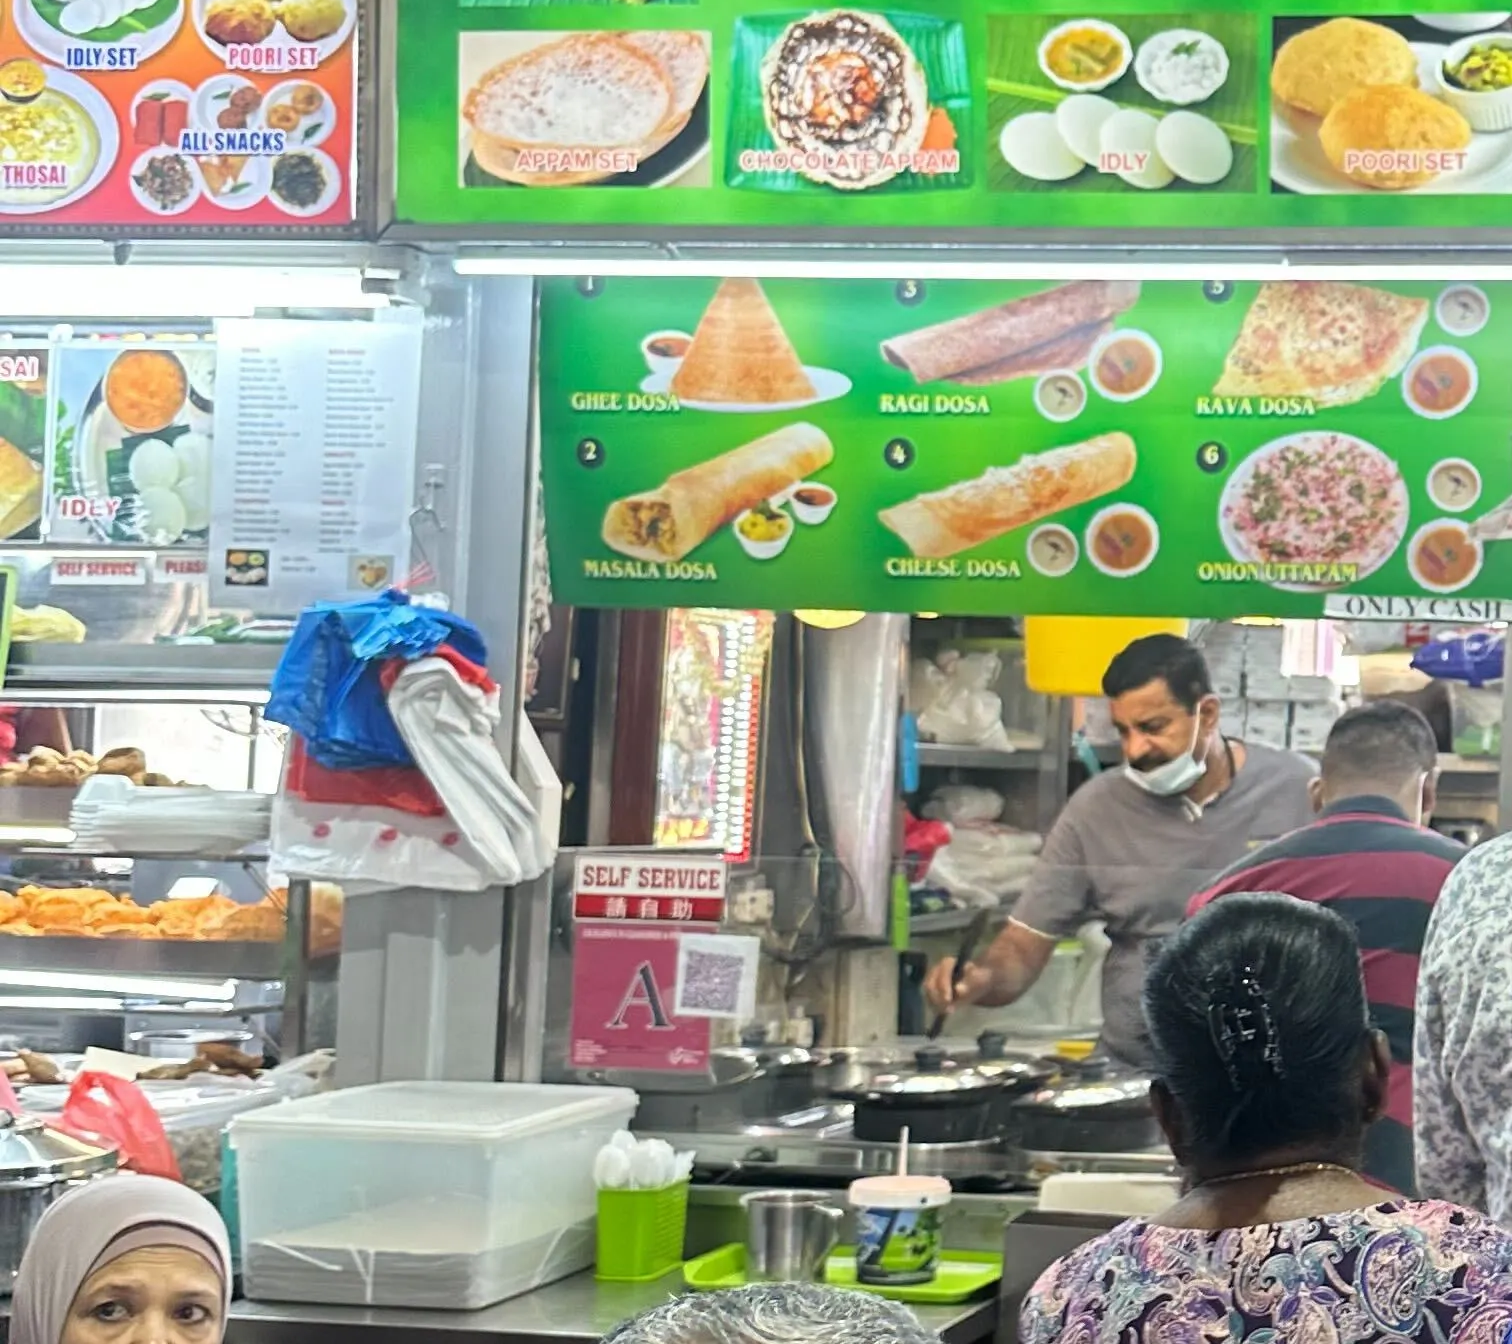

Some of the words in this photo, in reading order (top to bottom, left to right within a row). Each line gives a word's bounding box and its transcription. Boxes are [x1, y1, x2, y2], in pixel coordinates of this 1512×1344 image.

[66, 47, 104, 66] IDLY
[107, 47, 137, 66] SET
[229, 47, 282, 66] POORI
[288, 47, 318, 66] SET
[181, 131, 210, 151] ALL
[214, 131, 284, 152] SNACKS
[517, 151, 592, 171] APPAM
[596, 151, 639, 171] SET
[741, 151, 875, 171] CHOCOLATE
[880, 152, 957, 171] APPAM
[1100, 152, 1147, 171] IDLY
[1346, 152, 1419, 172] POORI
[1424, 152, 1467, 171] SET
[3, 165, 66, 184] THOSAI
[571, 392, 623, 411] GHEE
[627, 392, 681, 411] DOSA
[879, 394, 930, 413] RAGI
[934, 394, 991, 414] DOSA
[1196, 397, 1253, 416] RAVA
[1259, 397, 1316, 416] DOSA
[583, 440, 597, 461] 2
[1203, 444, 1220, 465] 6
[583, 560, 660, 579] MASALA
[665, 561, 717, 580] DOSA
[886, 558, 961, 577] CHEESE
[966, 559, 1021, 578] DOSA
[1198, 562, 1260, 582] ONION
[1265, 562, 1358, 583] UTTAPAM
[1345, 597, 1422, 617] ONLY
[1430, 598, 1502, 619] CASH
[583, 864, 631, 887] SELF
[638, 866, 721, 890] SERVICE
[604, 959, 677, 1031] A
